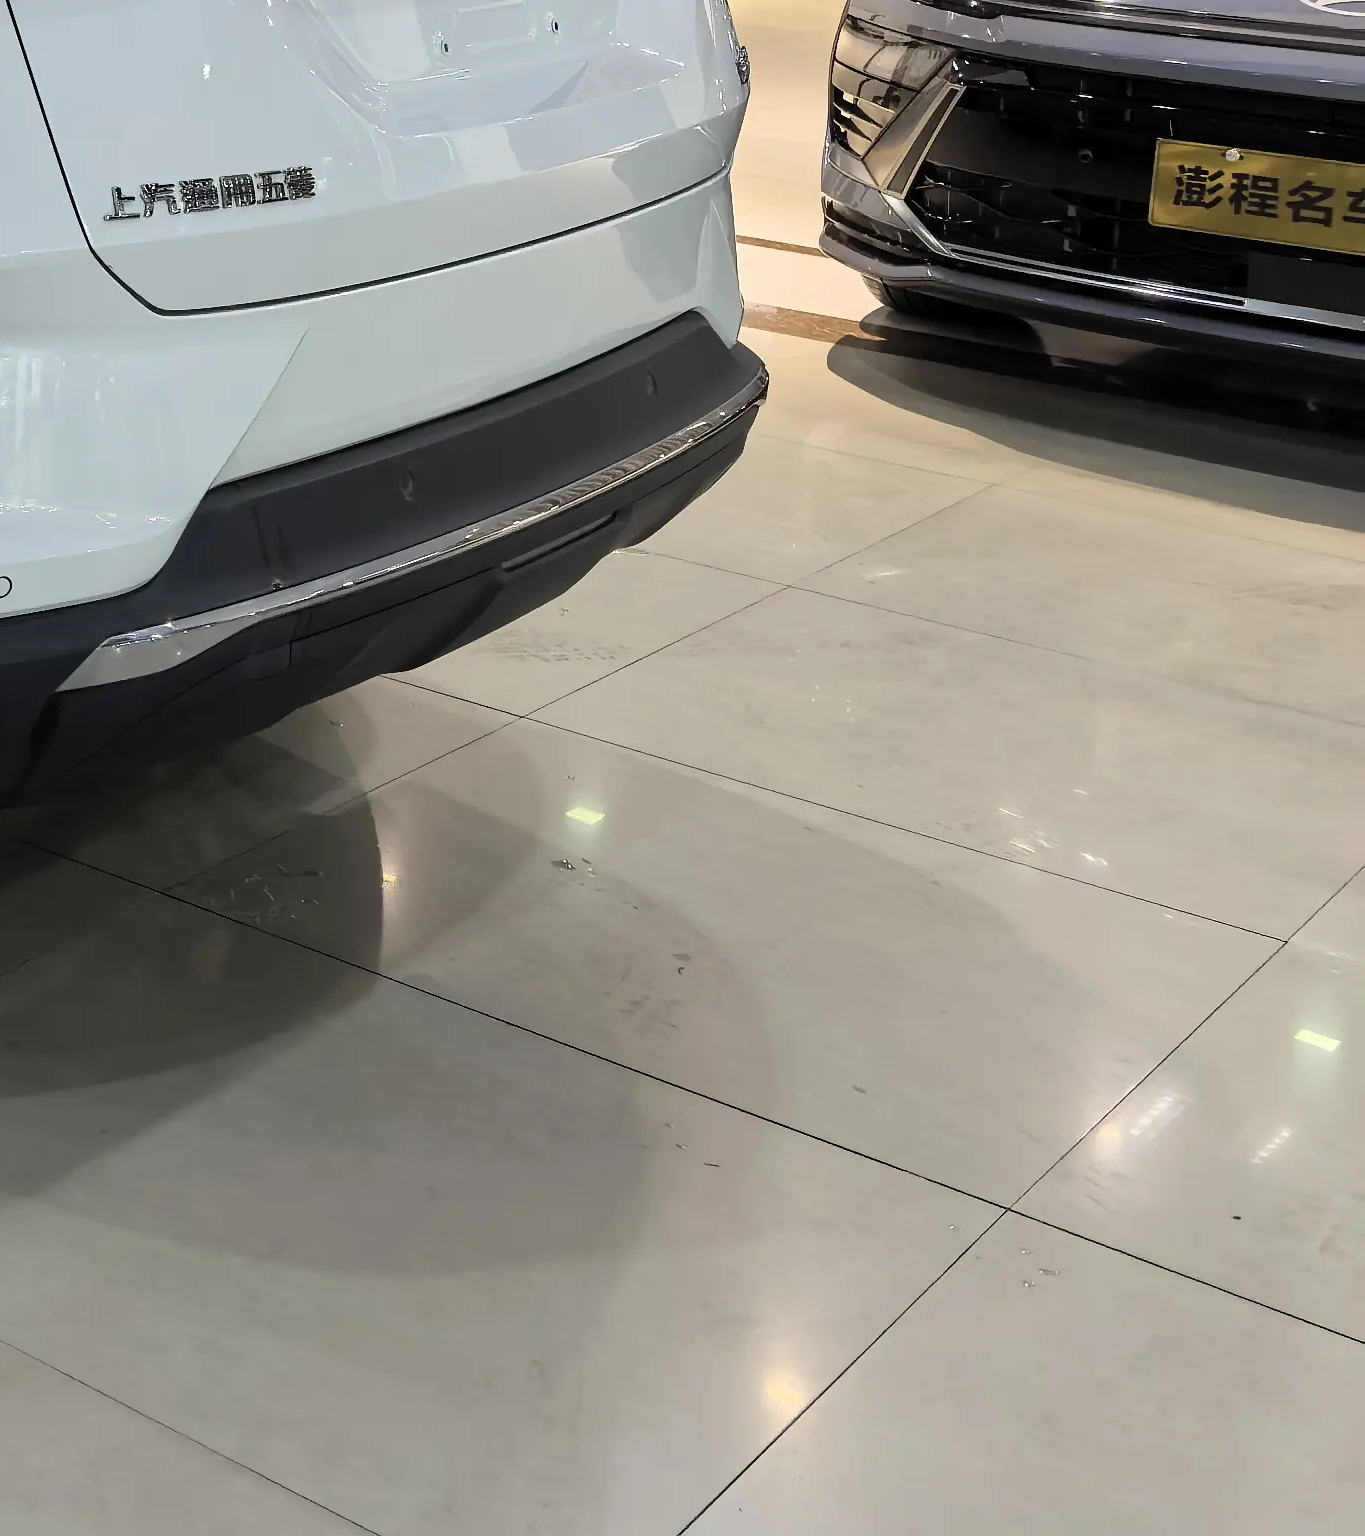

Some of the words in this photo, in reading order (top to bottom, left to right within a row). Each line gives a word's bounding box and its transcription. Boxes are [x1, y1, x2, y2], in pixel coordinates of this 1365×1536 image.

[103, 165, 317, 222] 上汽通用五菱
